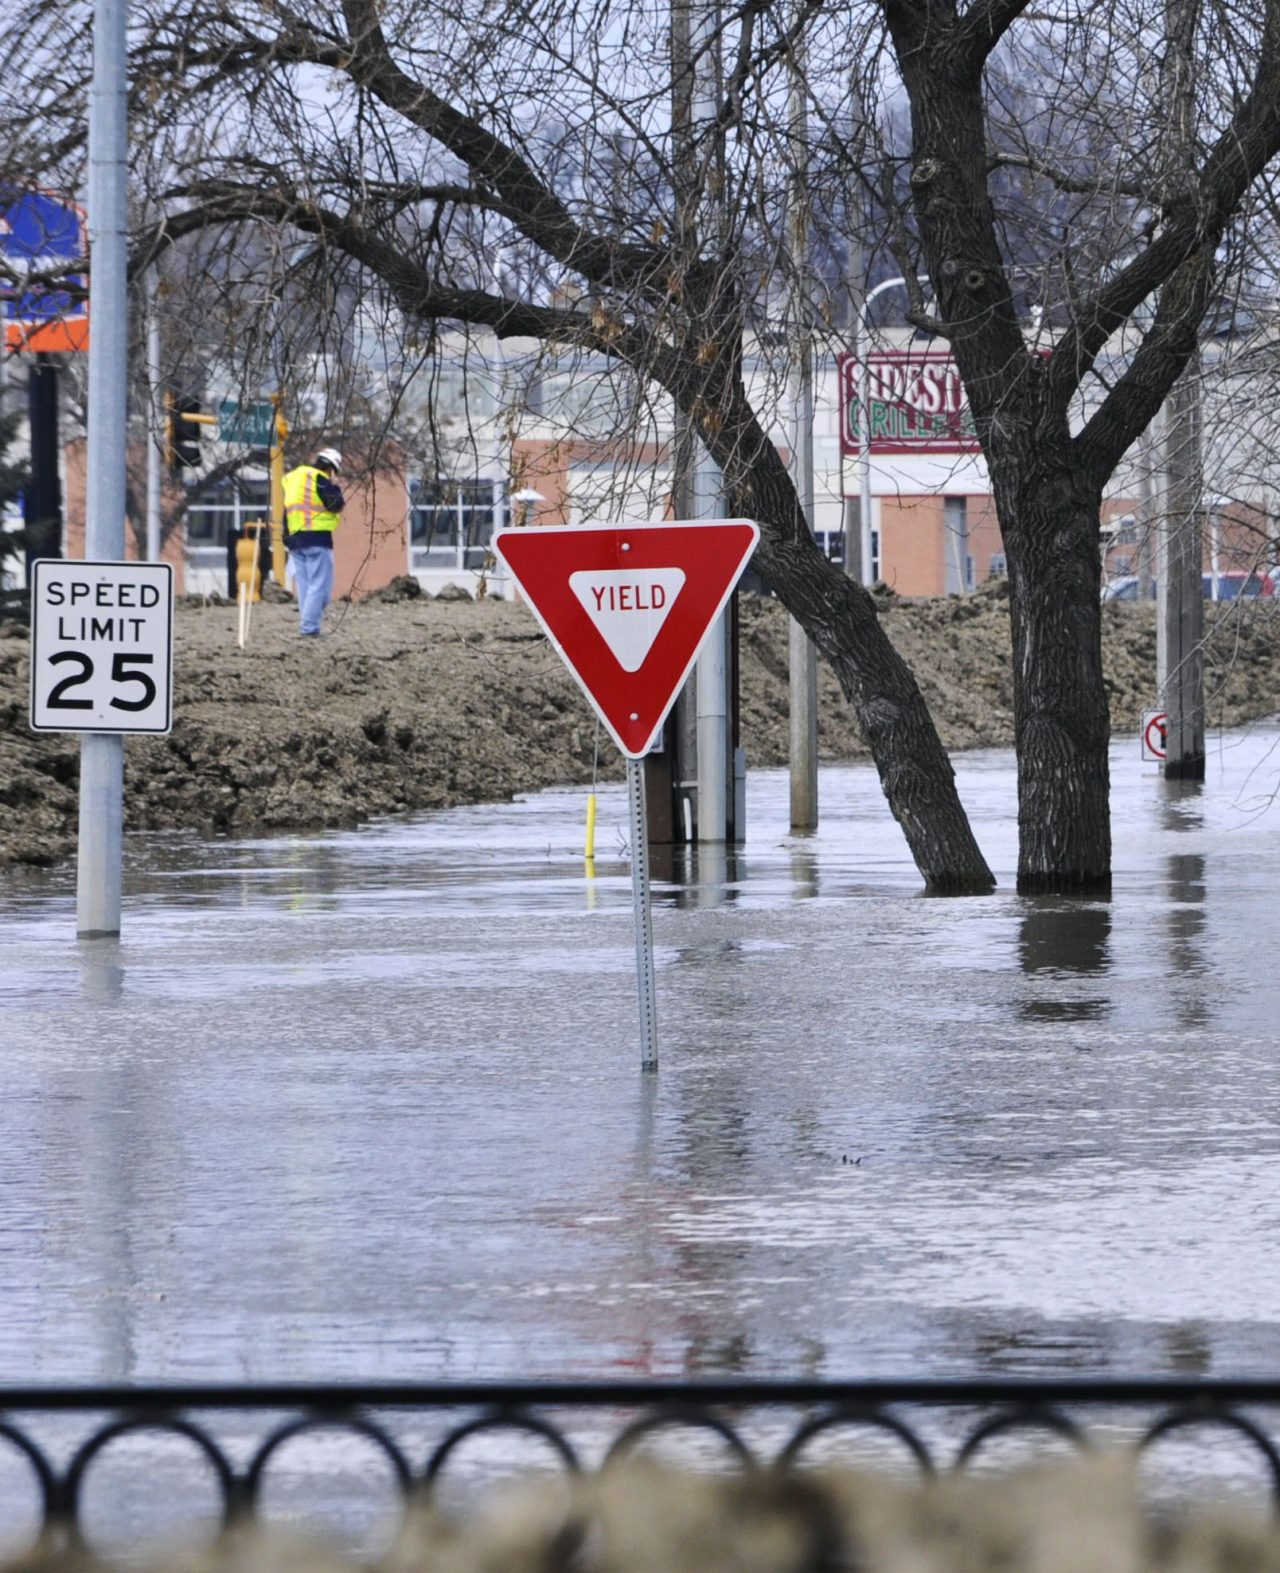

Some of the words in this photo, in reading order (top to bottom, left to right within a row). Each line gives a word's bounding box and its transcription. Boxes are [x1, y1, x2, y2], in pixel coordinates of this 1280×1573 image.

[46, 581, 160, 608] SPEED
[591, 584, 666, 611] YIELD
[58, 616, 146, 642] LIMIT
[46, 650, 157, 712] 25
